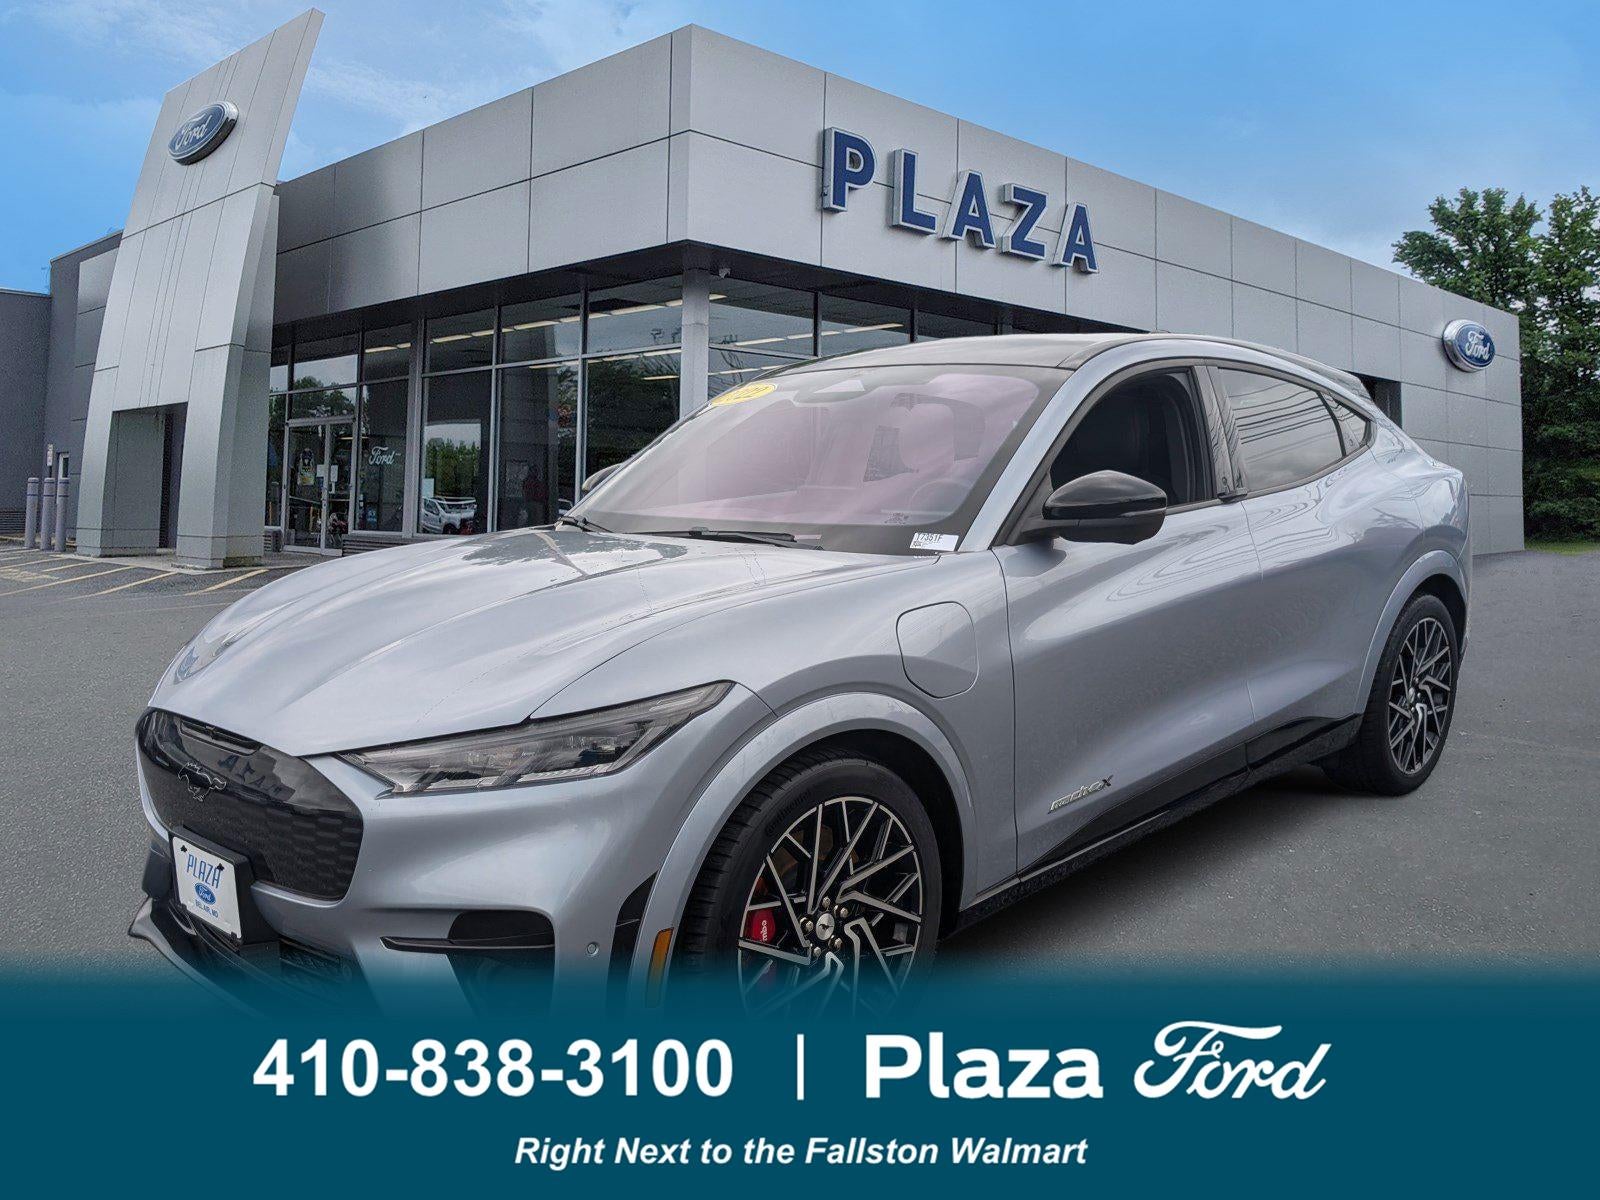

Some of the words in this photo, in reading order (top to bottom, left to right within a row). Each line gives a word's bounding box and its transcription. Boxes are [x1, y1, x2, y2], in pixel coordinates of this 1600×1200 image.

[174, 113, 213, 151] Ford
[822, 127, 1099, 273] PLAZA
[1464, 330, 1490, 361] Ford
[369, 445, 397, 466] Ford
[186, 853, 223, 889] PLAZA
